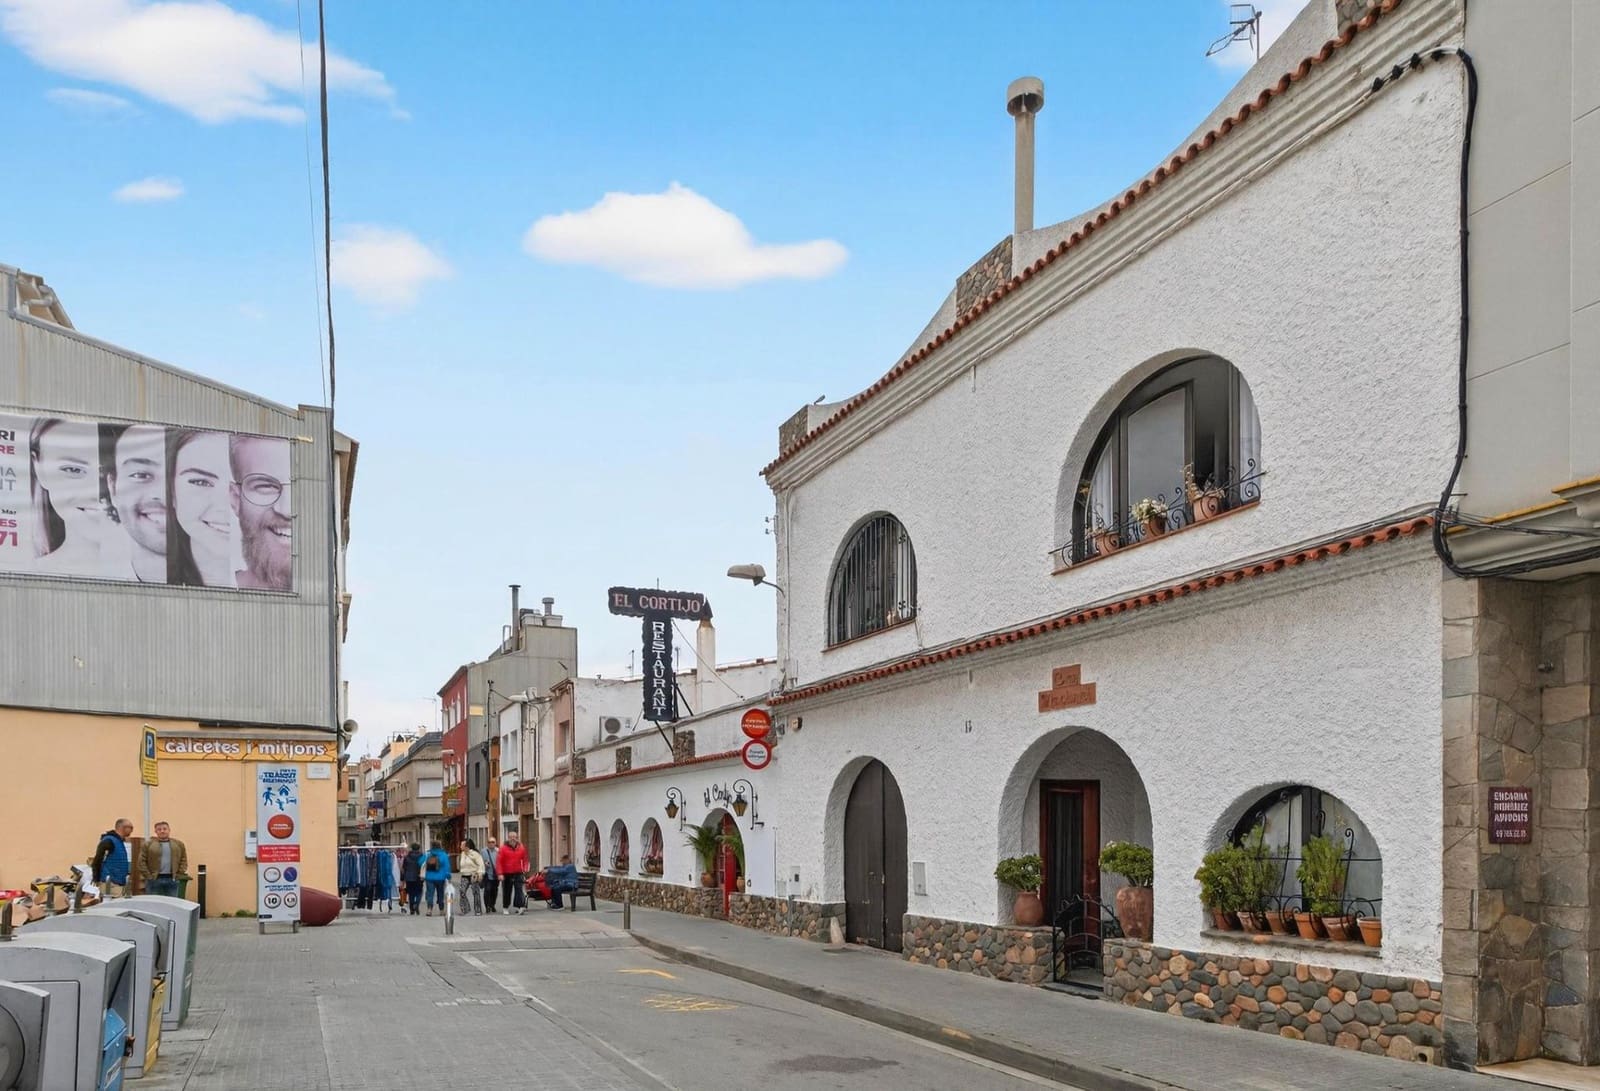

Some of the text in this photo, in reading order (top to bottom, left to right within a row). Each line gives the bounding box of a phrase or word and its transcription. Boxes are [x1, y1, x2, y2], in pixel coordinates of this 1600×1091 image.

[613, 593, 700, 613] EL CORTIJO
[652, 621, 667, 716] RESTAURANT
[165, 738, 326, 760] calcetes i mitjons
